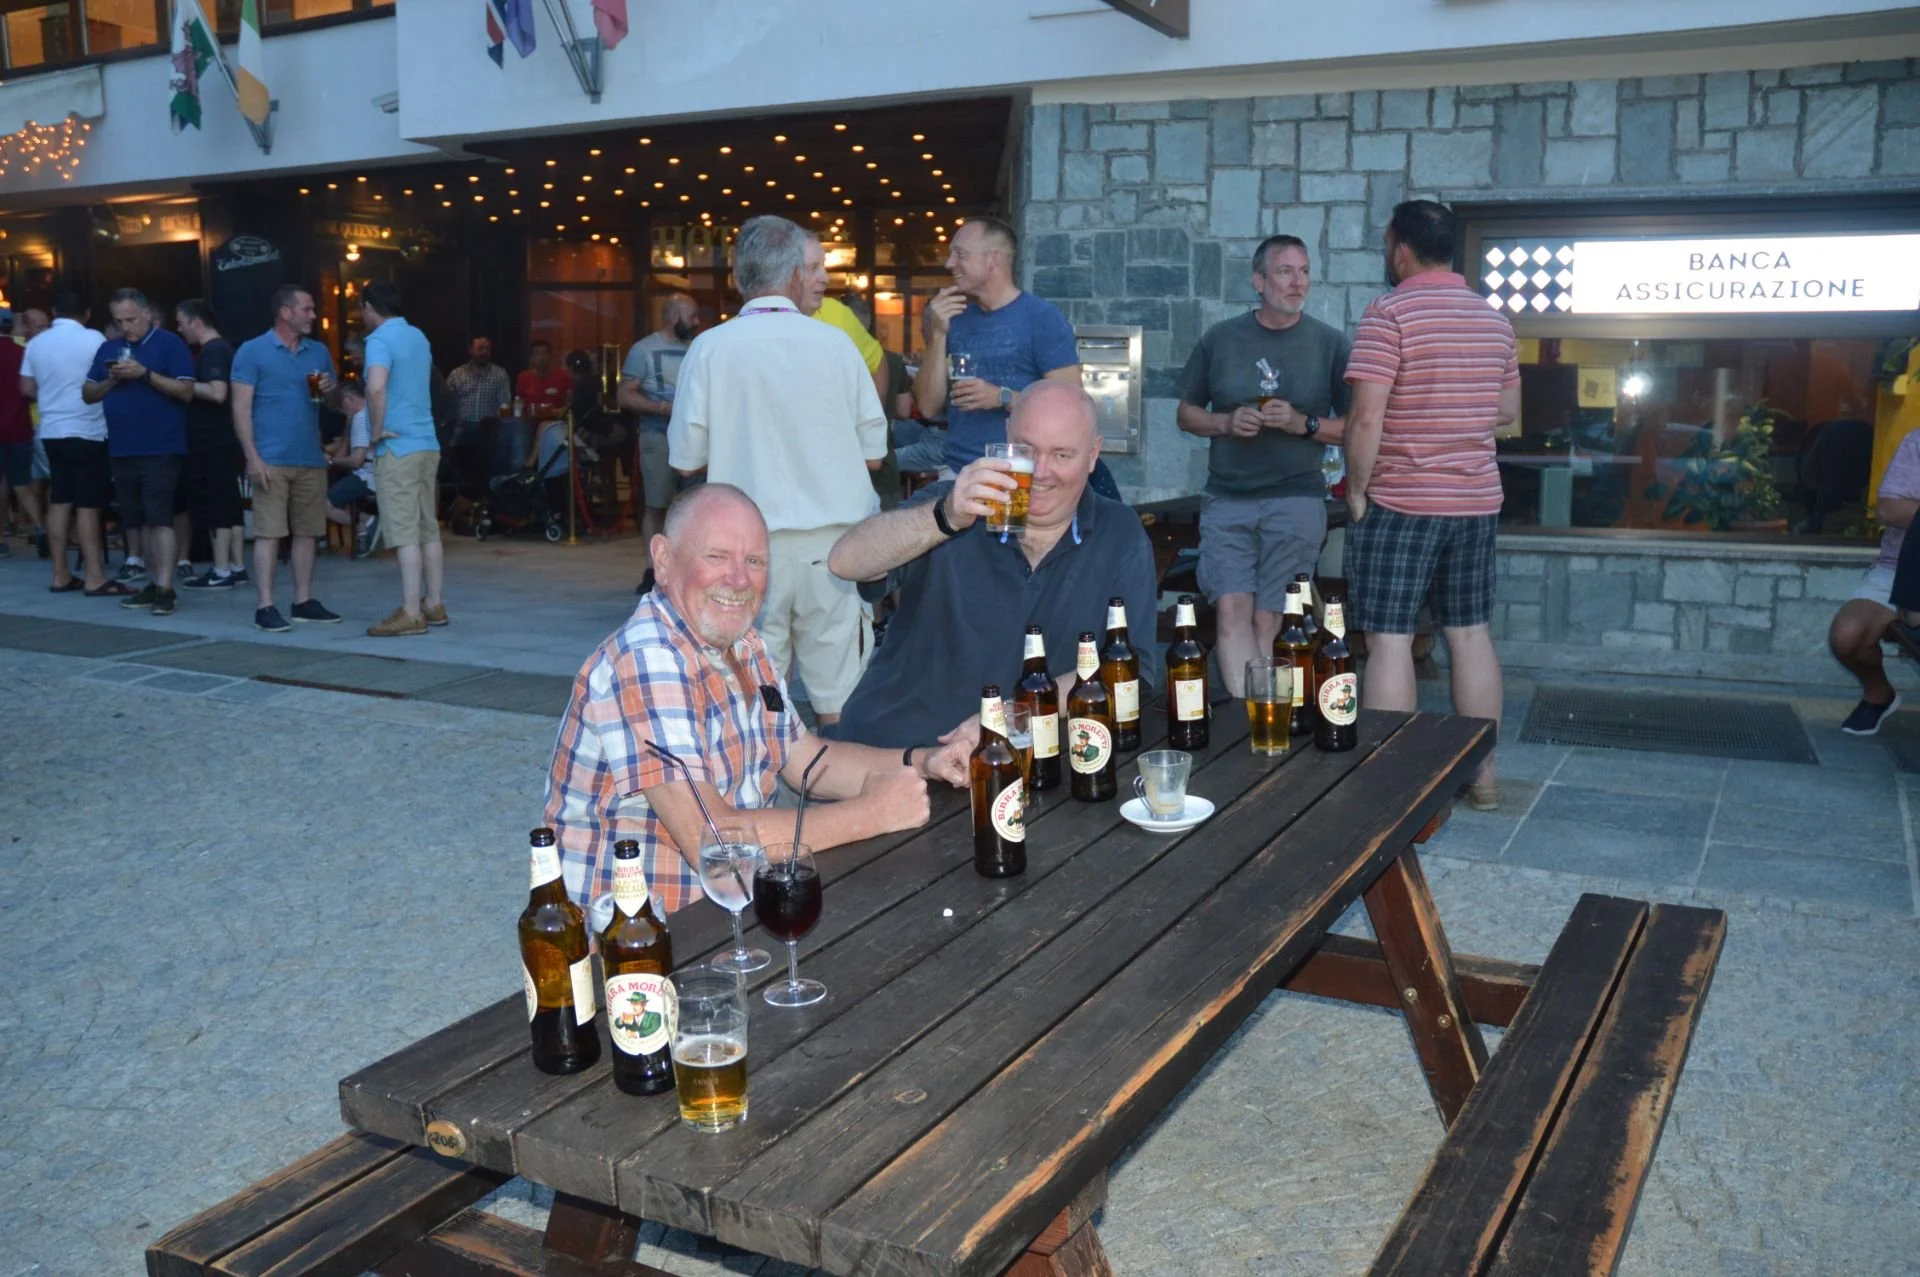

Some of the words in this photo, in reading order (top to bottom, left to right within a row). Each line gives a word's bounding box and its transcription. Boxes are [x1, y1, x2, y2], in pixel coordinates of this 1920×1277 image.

[1689, 251, 1792, 271] BANCA
[1616, 278, 1865, 301] ASSICURAZIONE
[997, 789, 1017, 821] BIRRA
